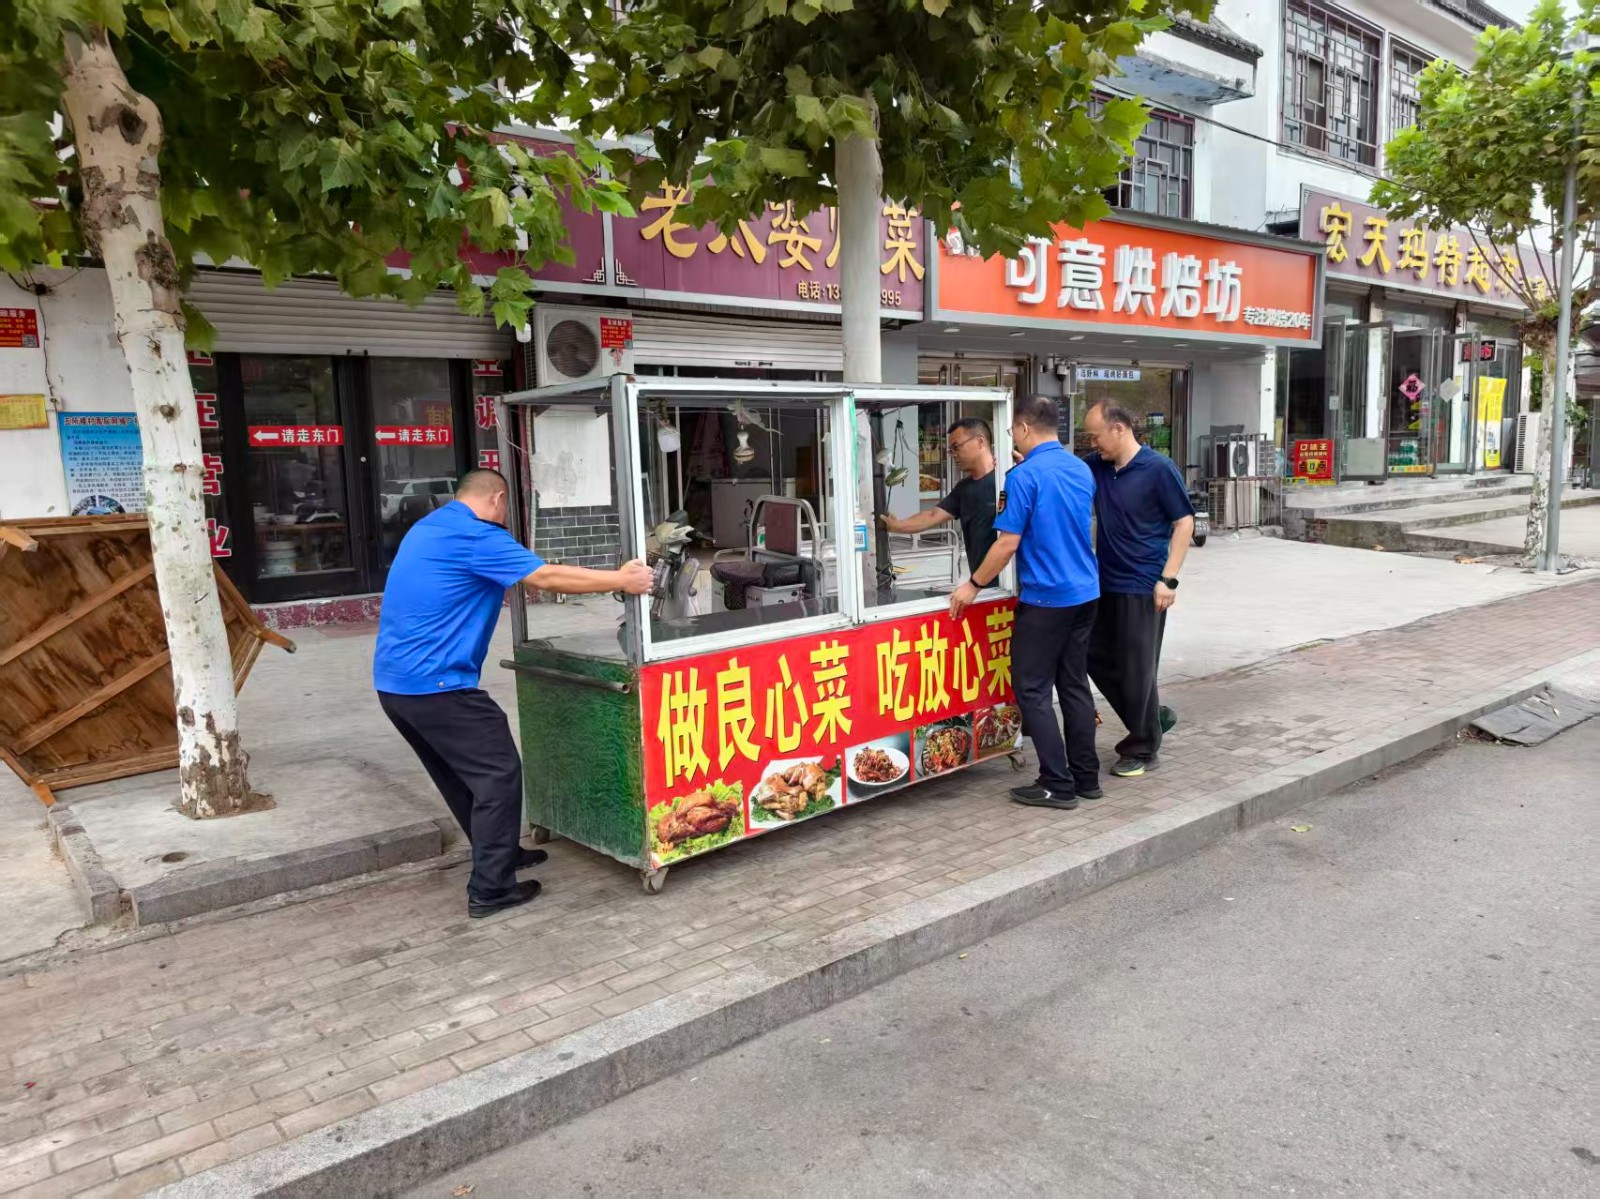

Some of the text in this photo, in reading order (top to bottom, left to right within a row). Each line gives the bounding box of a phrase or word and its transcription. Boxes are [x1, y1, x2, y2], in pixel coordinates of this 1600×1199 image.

[641, 179, 926, 283] 老太婆菜
[1005, 235, 1244, 322] 可意烘焙坊
[281, 428, 340, 444] 请走东门
[398, 428, 450, 443] 请走东门
[656, 606, 1014, 788] 做良心菜 吃放心菜
